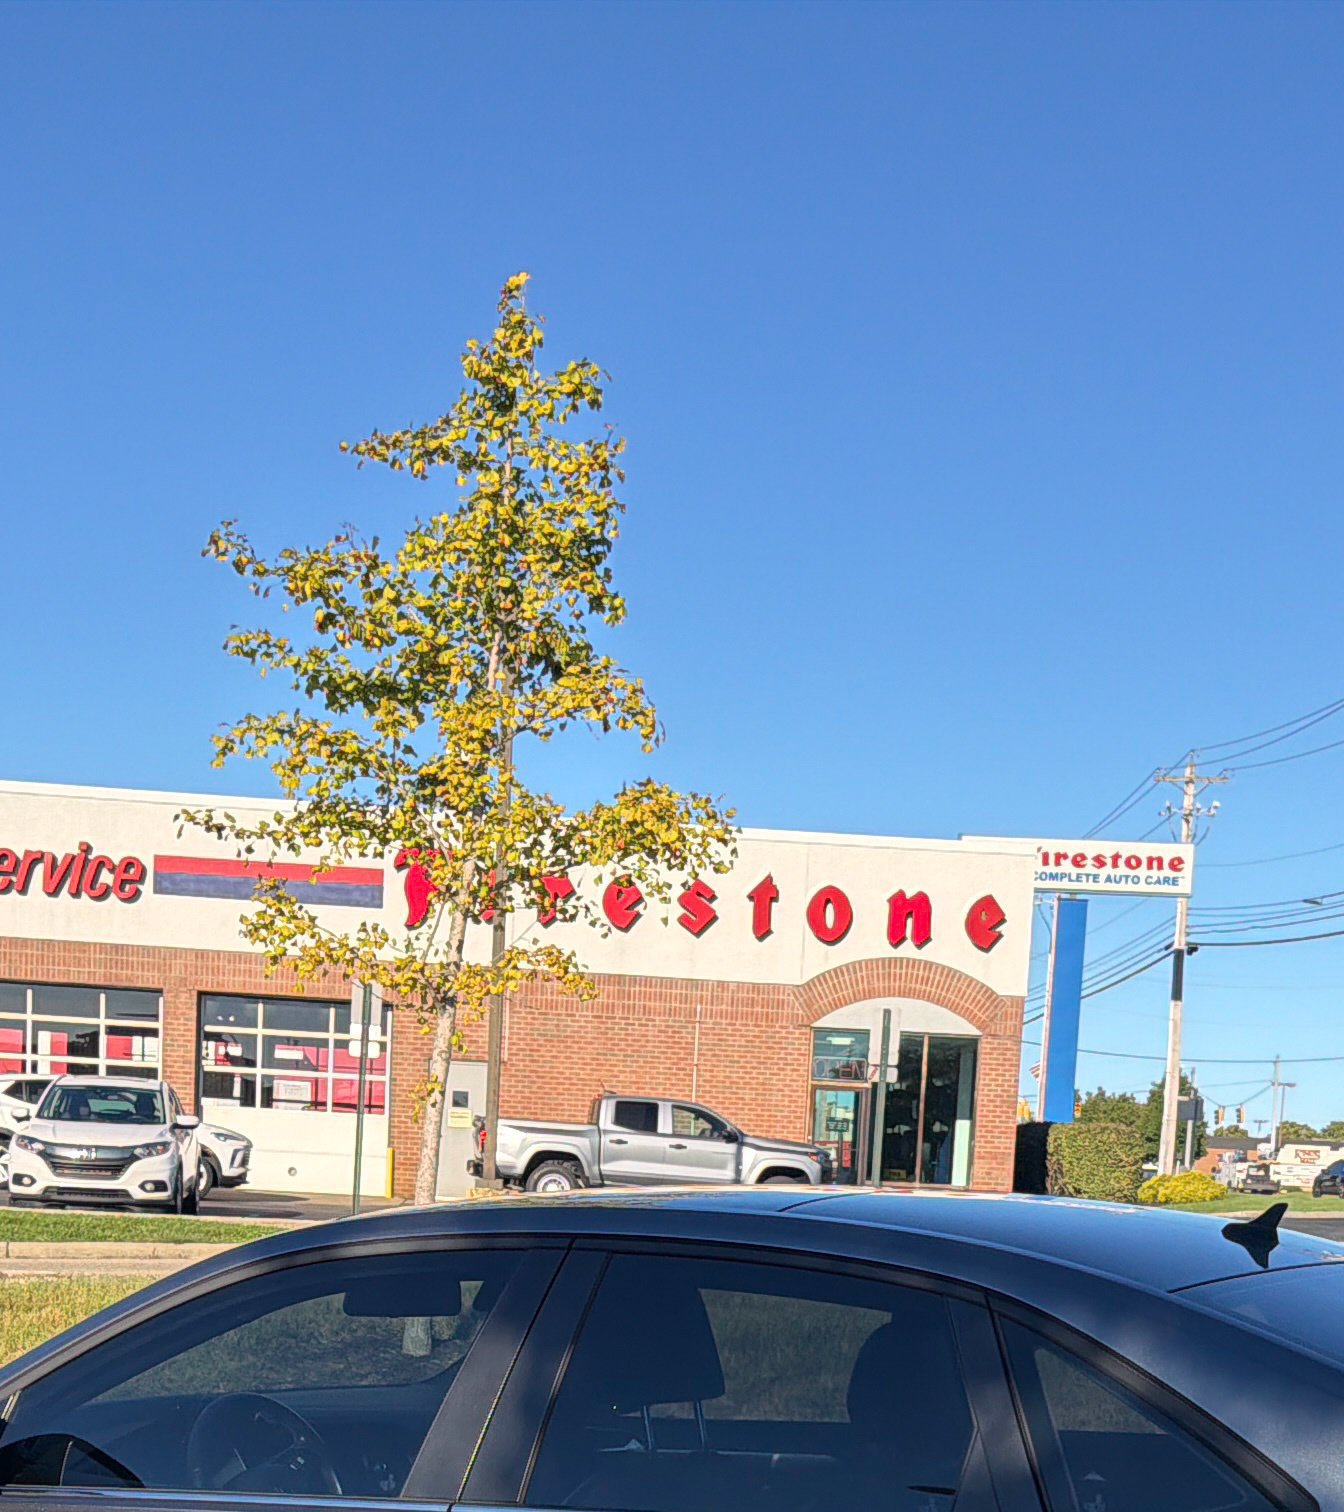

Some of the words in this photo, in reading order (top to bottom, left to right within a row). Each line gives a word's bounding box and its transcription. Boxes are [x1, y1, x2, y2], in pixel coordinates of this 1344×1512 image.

[1036, 846, 1186, 873] irestone
[1104, 874, 1141, 886] AUTO
[1144, 876, 1180, 887] CARE
